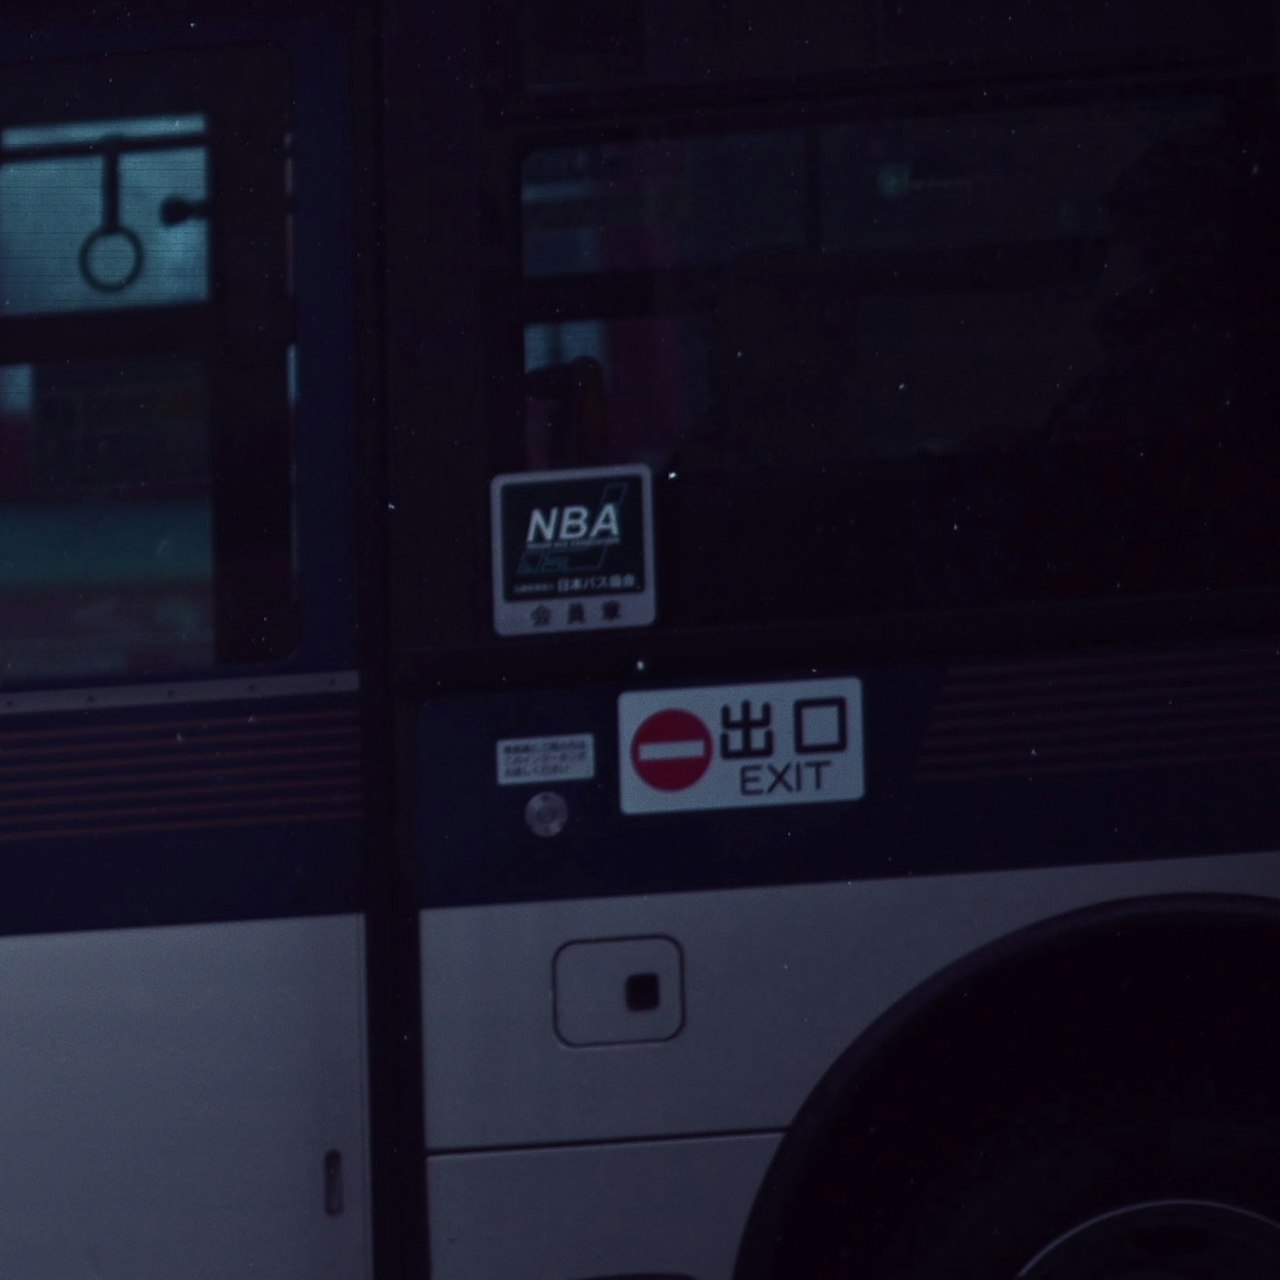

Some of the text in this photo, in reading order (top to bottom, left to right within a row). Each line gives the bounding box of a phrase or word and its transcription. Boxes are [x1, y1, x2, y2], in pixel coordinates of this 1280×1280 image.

[526, 502, 621, 542] NBA
[721, 698, 847, 759] 出口
[740, 760, 831, 795] EXIT
